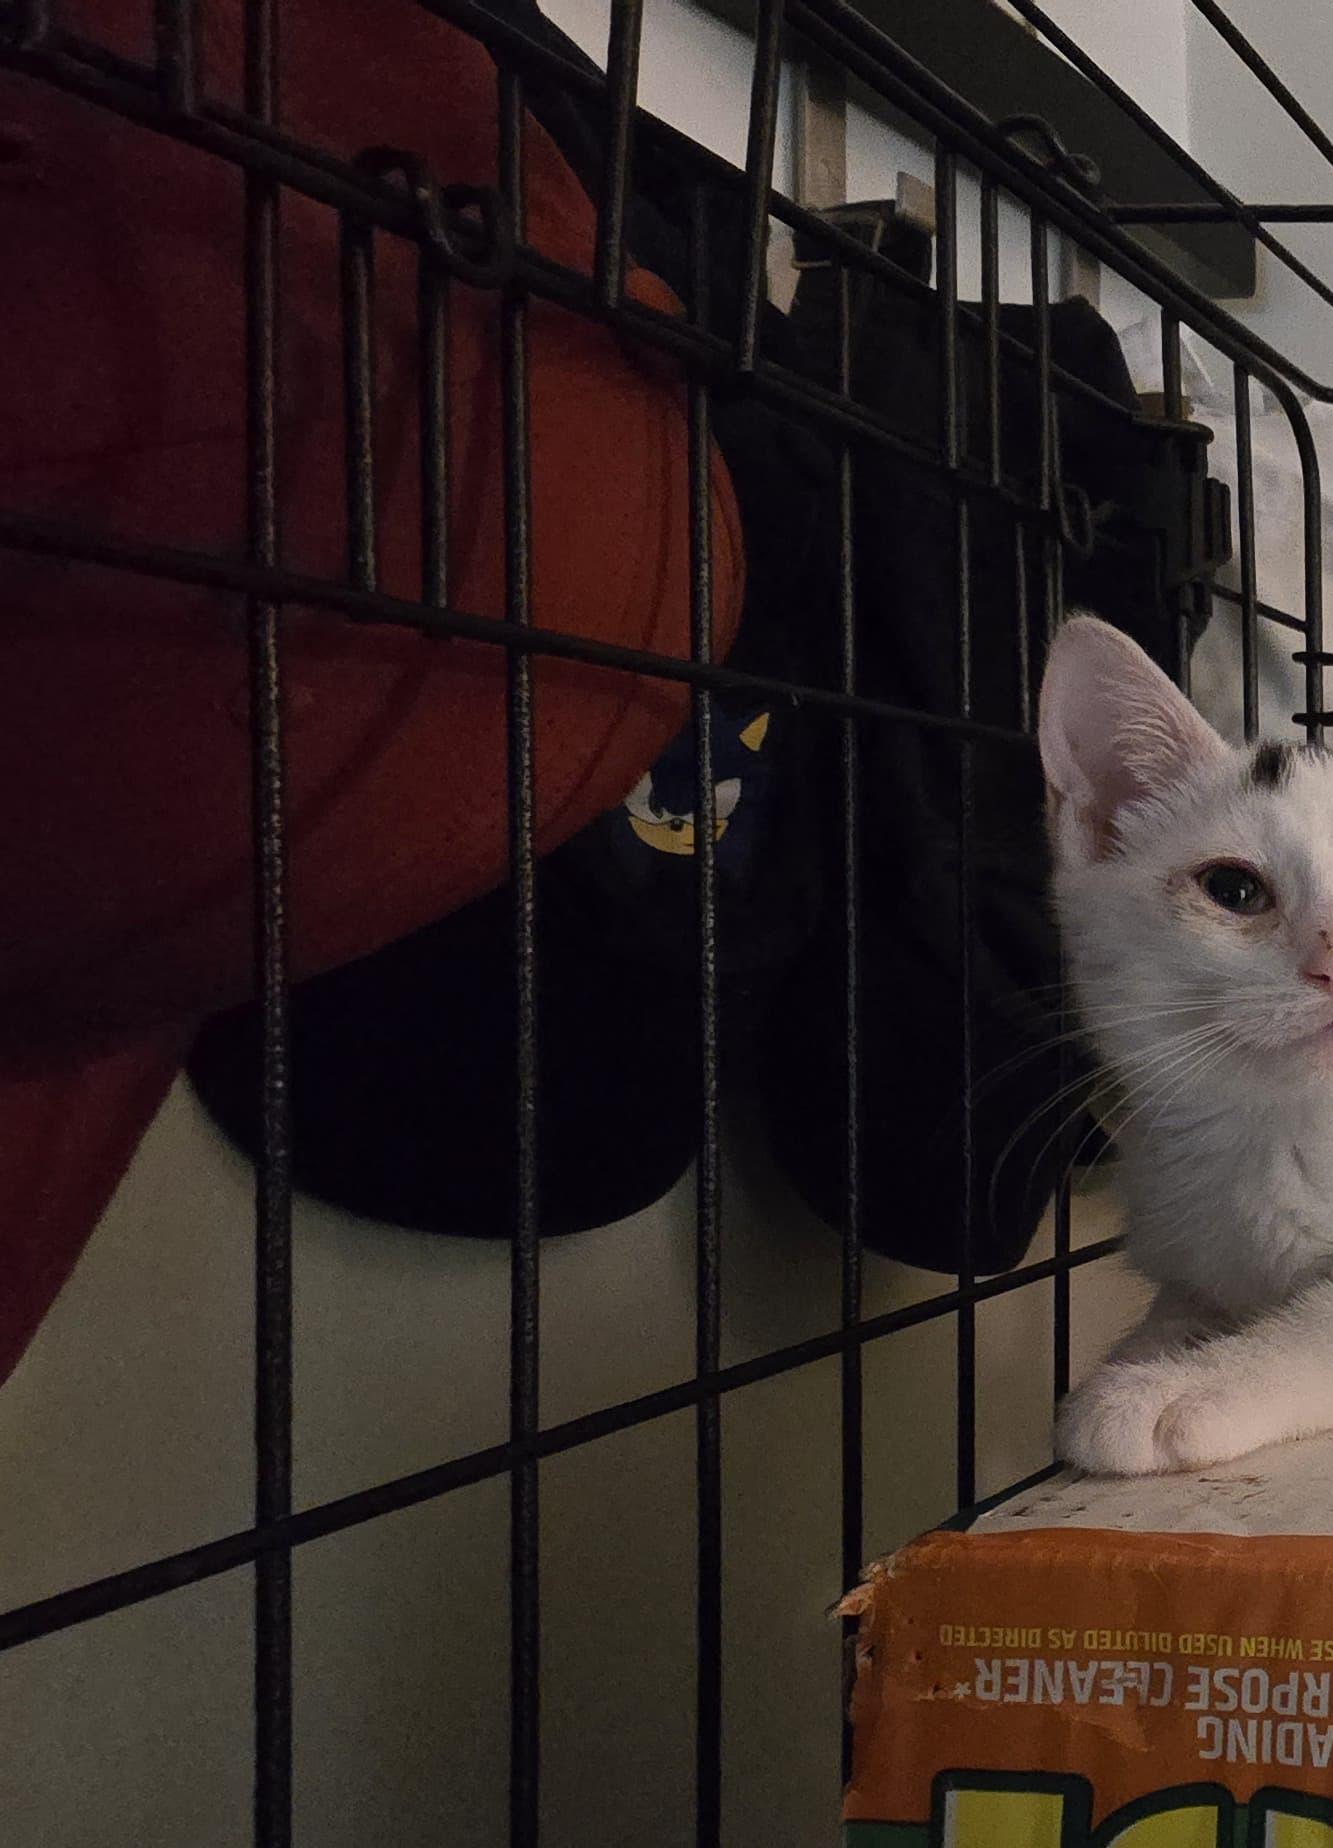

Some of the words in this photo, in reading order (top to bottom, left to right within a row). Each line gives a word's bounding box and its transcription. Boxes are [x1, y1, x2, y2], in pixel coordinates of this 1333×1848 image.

[939, 1624, 1042, 1648] DIRECTED
[1047, 1627, 1077, 1650] AS
[1083, 1629, 1173, 1655] DILUTED
[1178, 1632, 1235, 1657] USED
[1240, 1635, 1304, 1661] WHEN
